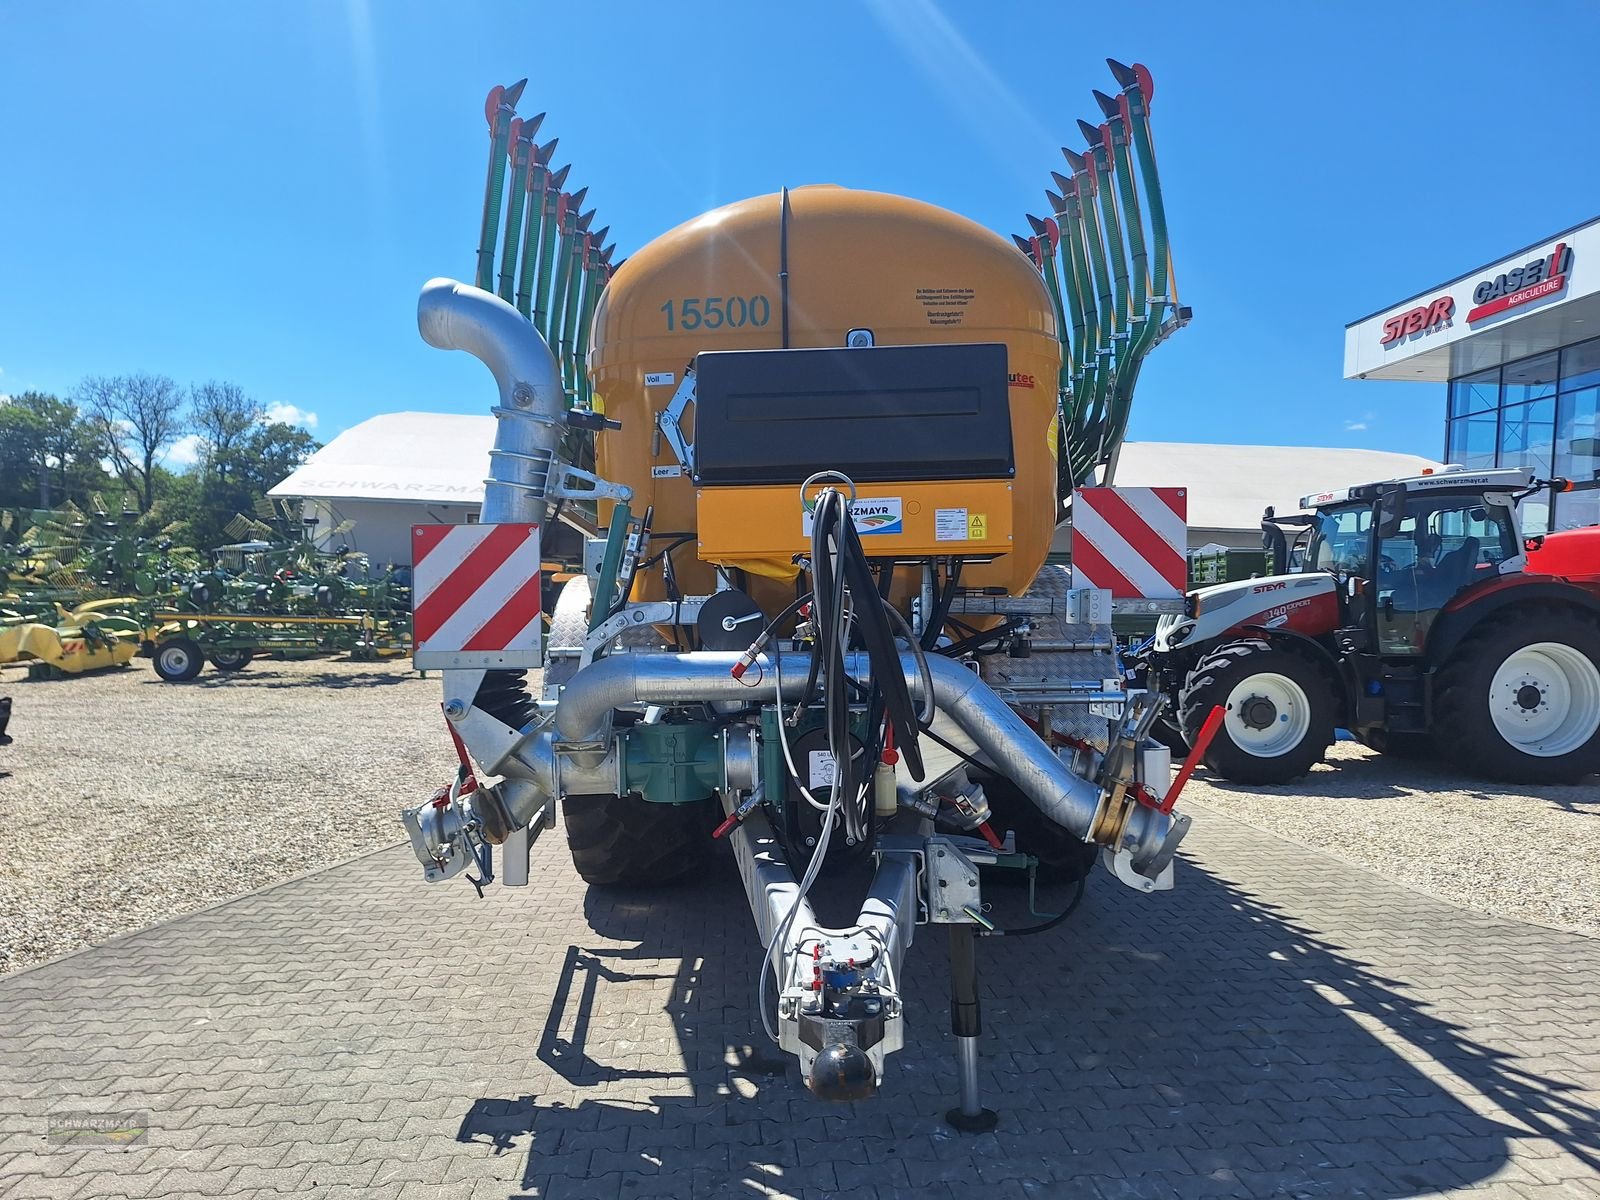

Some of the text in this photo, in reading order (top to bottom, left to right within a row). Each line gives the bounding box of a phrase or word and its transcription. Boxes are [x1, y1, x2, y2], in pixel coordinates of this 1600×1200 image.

[1508, 280, 1558, 305] AGRICULTURE
[661, 295, 770, 331] 15500
[1380, 295, 1455, 345] STEYR
[646, 375, 660, 383] Voll
[1008, 372, 1035, 383] utec
[301, 479, 485, 494] SCHWARZMA
[1417, 477, 1488, 486] www.schwarzmayr.at
[1316, 493, 1334, 502] STEYR
[848, 506, 889, 516] RZMAYR
[1253, 581, 1287, 594] STEYR
[1286, 599, 1311, 610] EXPERT
